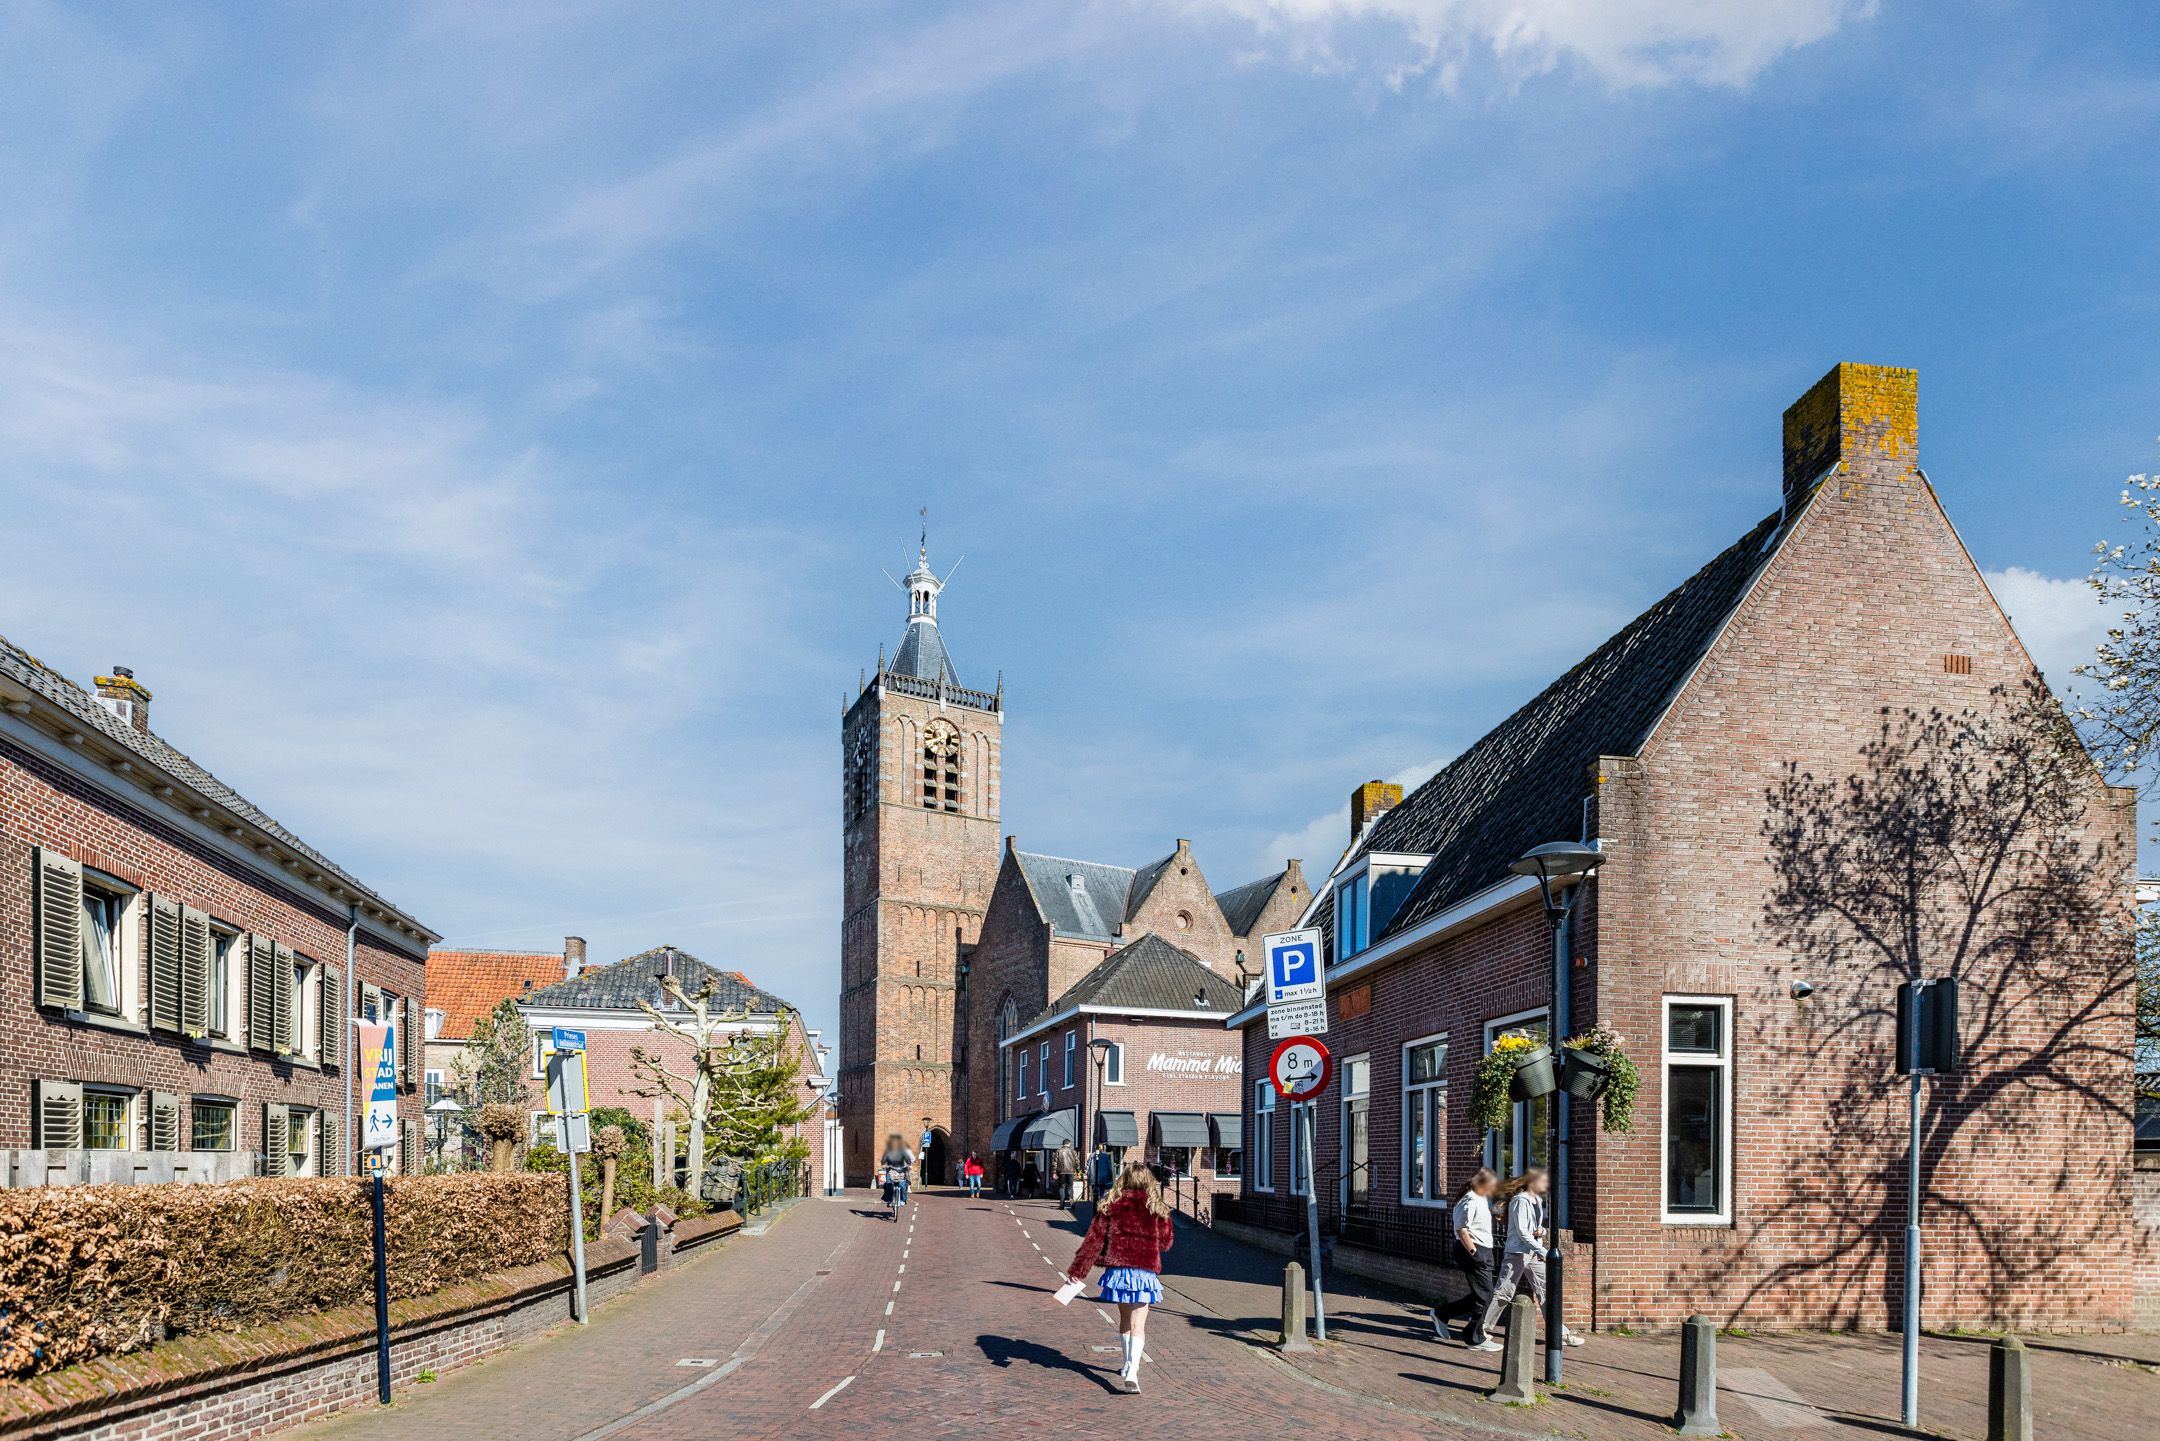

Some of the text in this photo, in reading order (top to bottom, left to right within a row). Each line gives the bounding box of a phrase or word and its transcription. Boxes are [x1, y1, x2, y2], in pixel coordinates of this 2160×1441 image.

[1280, 935, 1303, 943] ZONE
[1283, 950, 1305, 982] P
[1287, 1004, 1322, 1012] binnenstad
[364, 1048, 392, 1066] VRIJ
[1147, 1053, 1211, 1072] Mamma
[1288, 1053, 1312, 1069] 8 m
[365, 1067, 393, 1078] STAD
[366, 1082, 393, 1090] VIANEN
